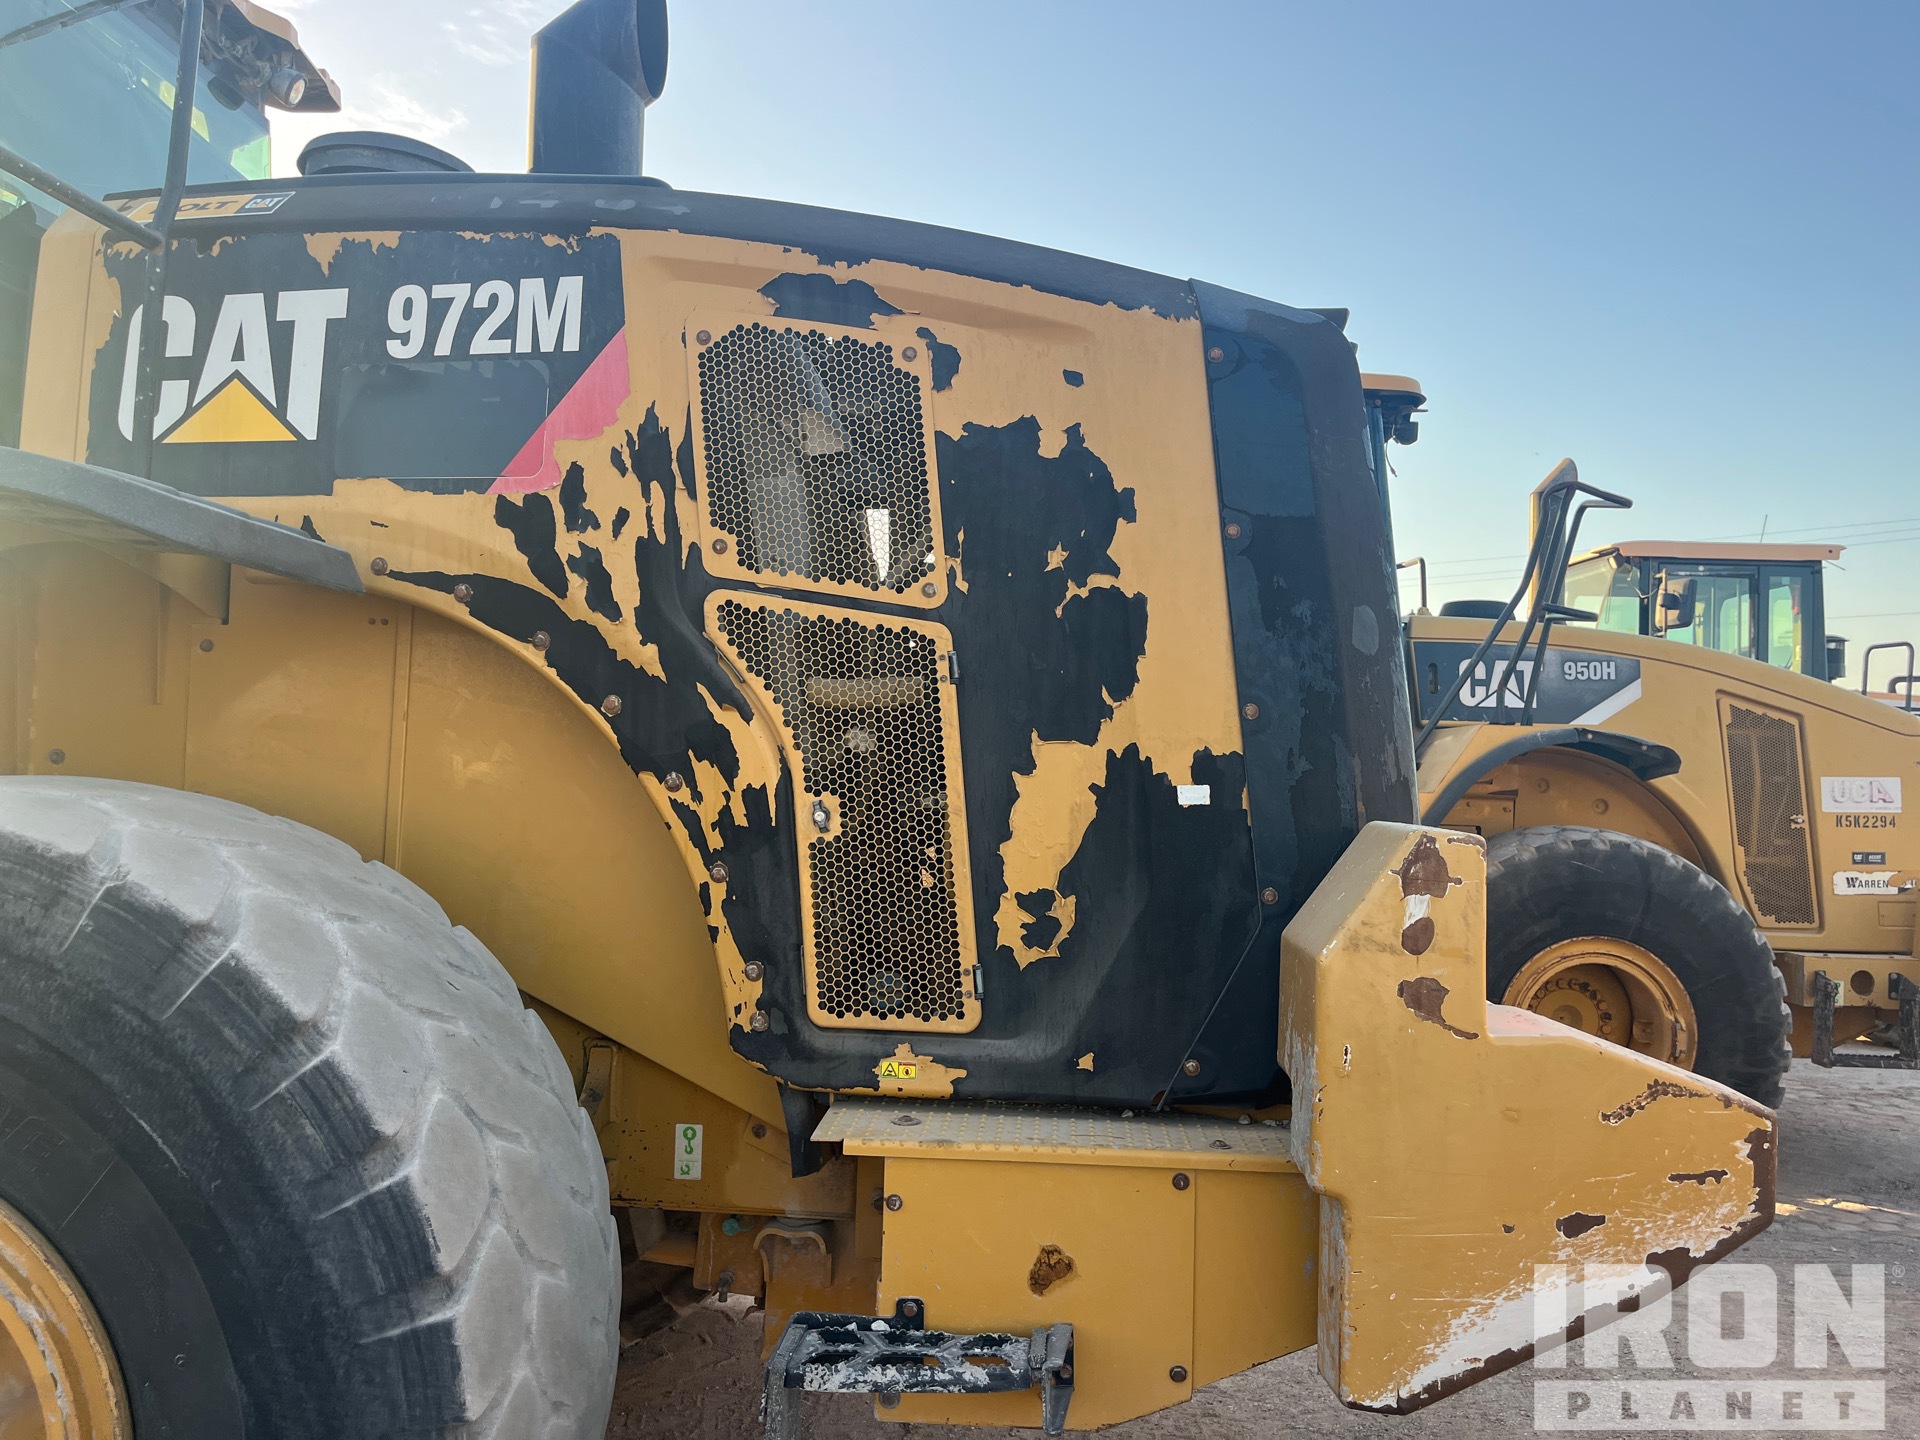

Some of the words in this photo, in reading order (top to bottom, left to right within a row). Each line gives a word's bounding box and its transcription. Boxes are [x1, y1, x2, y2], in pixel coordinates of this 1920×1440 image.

[244, 196, 284, 209] CAT
[118, 288, 349, 442] CAT
[386, 275, 584, 359] 972M
[1458, 658, 1544, 709] CAT
[1563, 661, 1616, 681] 950H
[1831, 780, 1894, 804] UCA
[1835, 814, 1896, 828] K5K2294
[1845, 876, 1889, 889] WARREN
